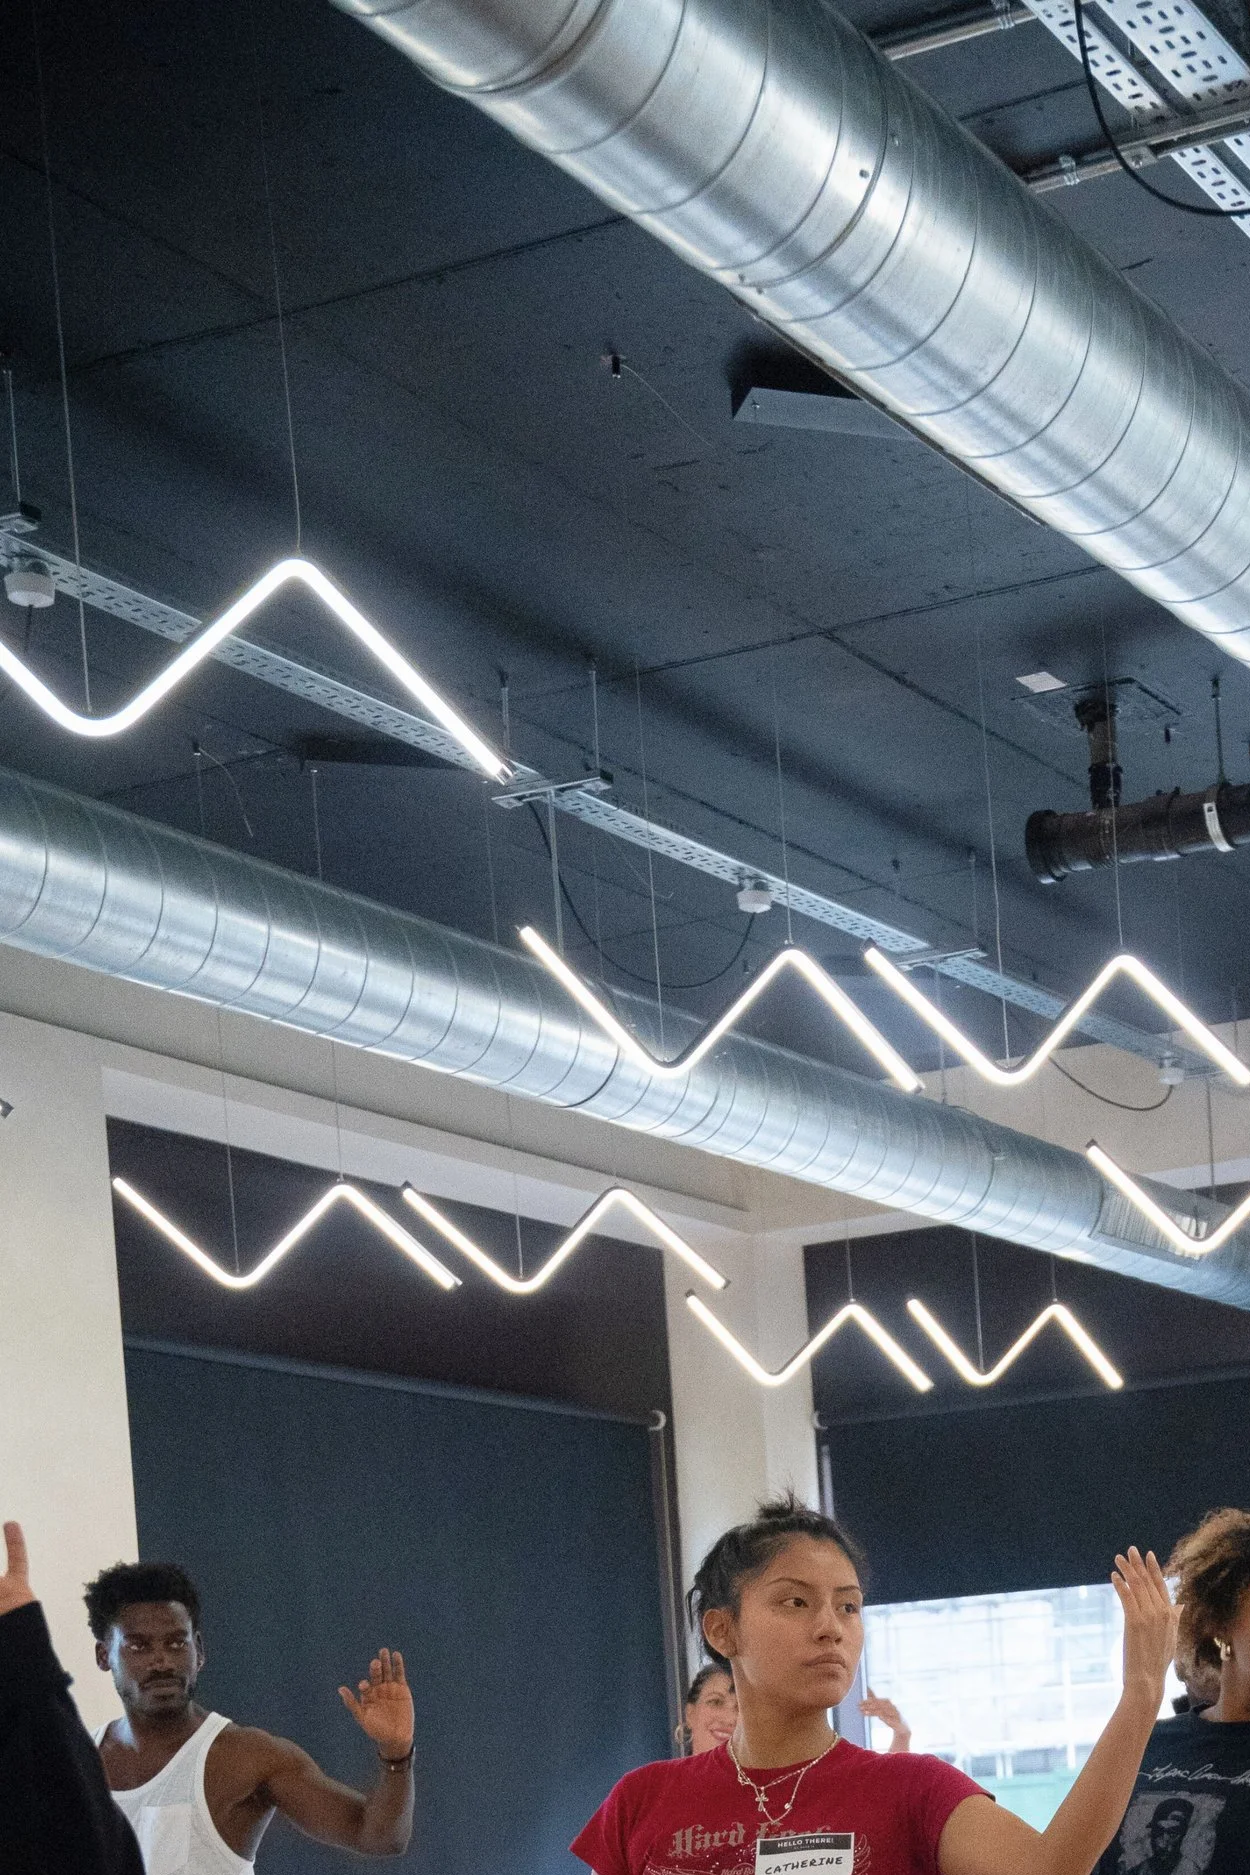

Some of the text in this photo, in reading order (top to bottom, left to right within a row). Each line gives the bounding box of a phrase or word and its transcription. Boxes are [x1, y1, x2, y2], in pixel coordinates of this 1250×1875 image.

[668, 1822, 746, 1858] Hard
[777, 1839, 803, 1848] HELLO
[805, 1837, 834, 1845] THERE!
[765, 1856, 843, 1875] CATHERINE
